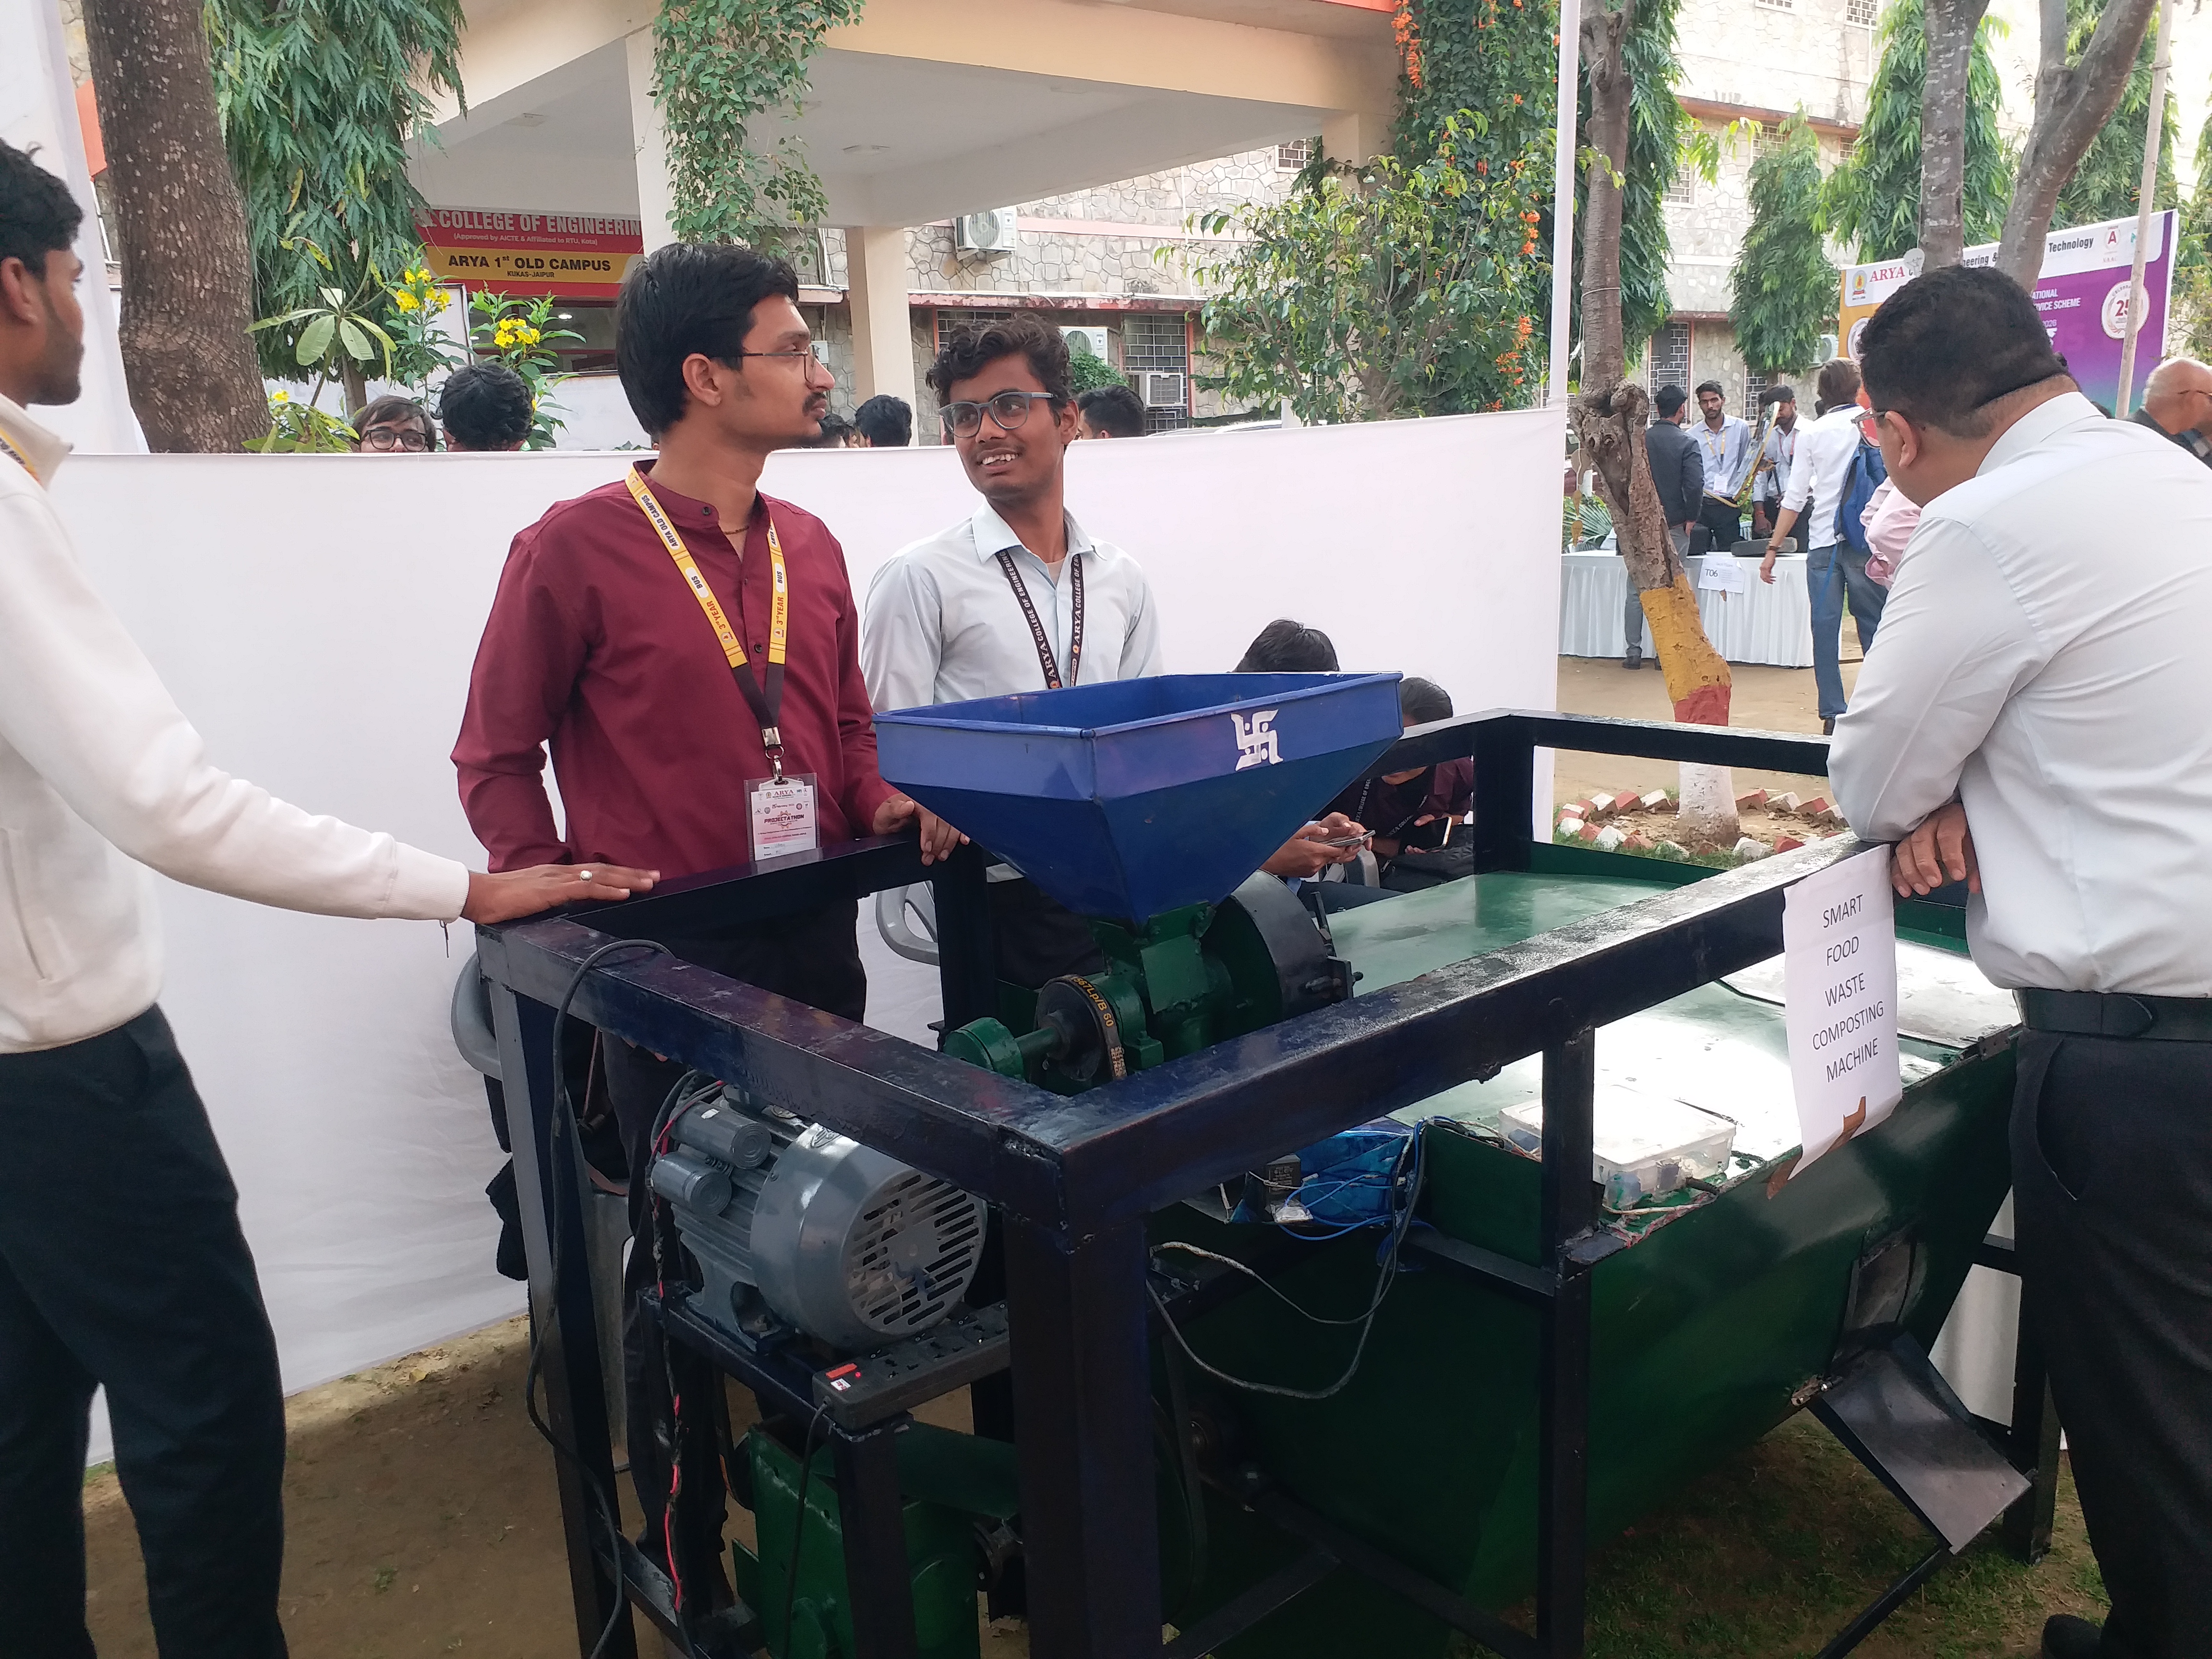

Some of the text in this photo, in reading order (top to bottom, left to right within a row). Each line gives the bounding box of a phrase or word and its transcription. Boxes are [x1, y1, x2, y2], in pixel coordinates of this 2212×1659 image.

[439, 210, 515, 231] COLLEGE
[520, 214, 541, 231] OF
[546, 216, 641, 236] ENGINEERIN
[2049, 238, 2094, 252] Technology
[2108, 231, 2116, 244] A
[448, 255, 611, 271] ARYA 1st OLD CAMPUS
[1869, 266, 1905, 282] ARYA
[2054, 298, 2081, 310] SCHEME
[641, 495, 678, 546] ARYA OLD CAMPUS
[1074, 568, 1080, 577] OF
[1705, 569, 1718, 577] T06
[691, 576, 703, 589] BUS
[999, 551, 1056, 678] ARYA COLLEGE OF ENGINEERING
[1358, 796, 1367, 812] COLLEGE
[764, 814, 804, 824] PROJECTATHON
[1823, 894, 1863, 928] SMART
[1826, 936, 1859, 966] FOOD
[1825, 973, 1865, 1007] WASTE
[1813, 1000, 1884, 1050] COMPOSTING
[1826, 1037, 1878, 1083] MACHINE
